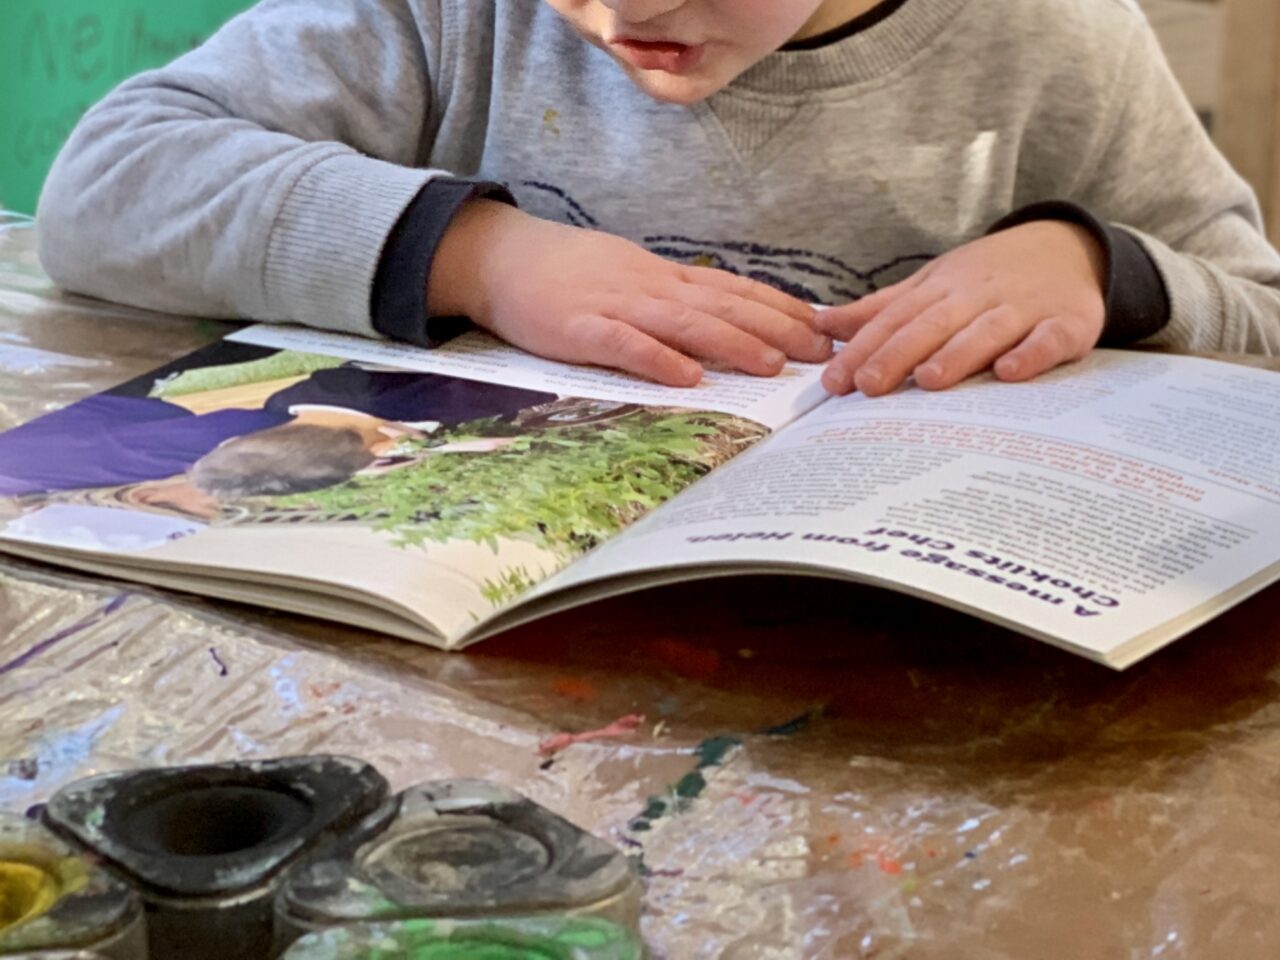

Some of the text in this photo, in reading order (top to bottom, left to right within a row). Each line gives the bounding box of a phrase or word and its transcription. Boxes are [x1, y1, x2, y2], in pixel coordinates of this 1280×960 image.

[802, 533, 891, 551] from
[865, 528, 955, 551] Chef
[900, 550, 1064, 605] message
[1074, 604, 1101, 617] A
